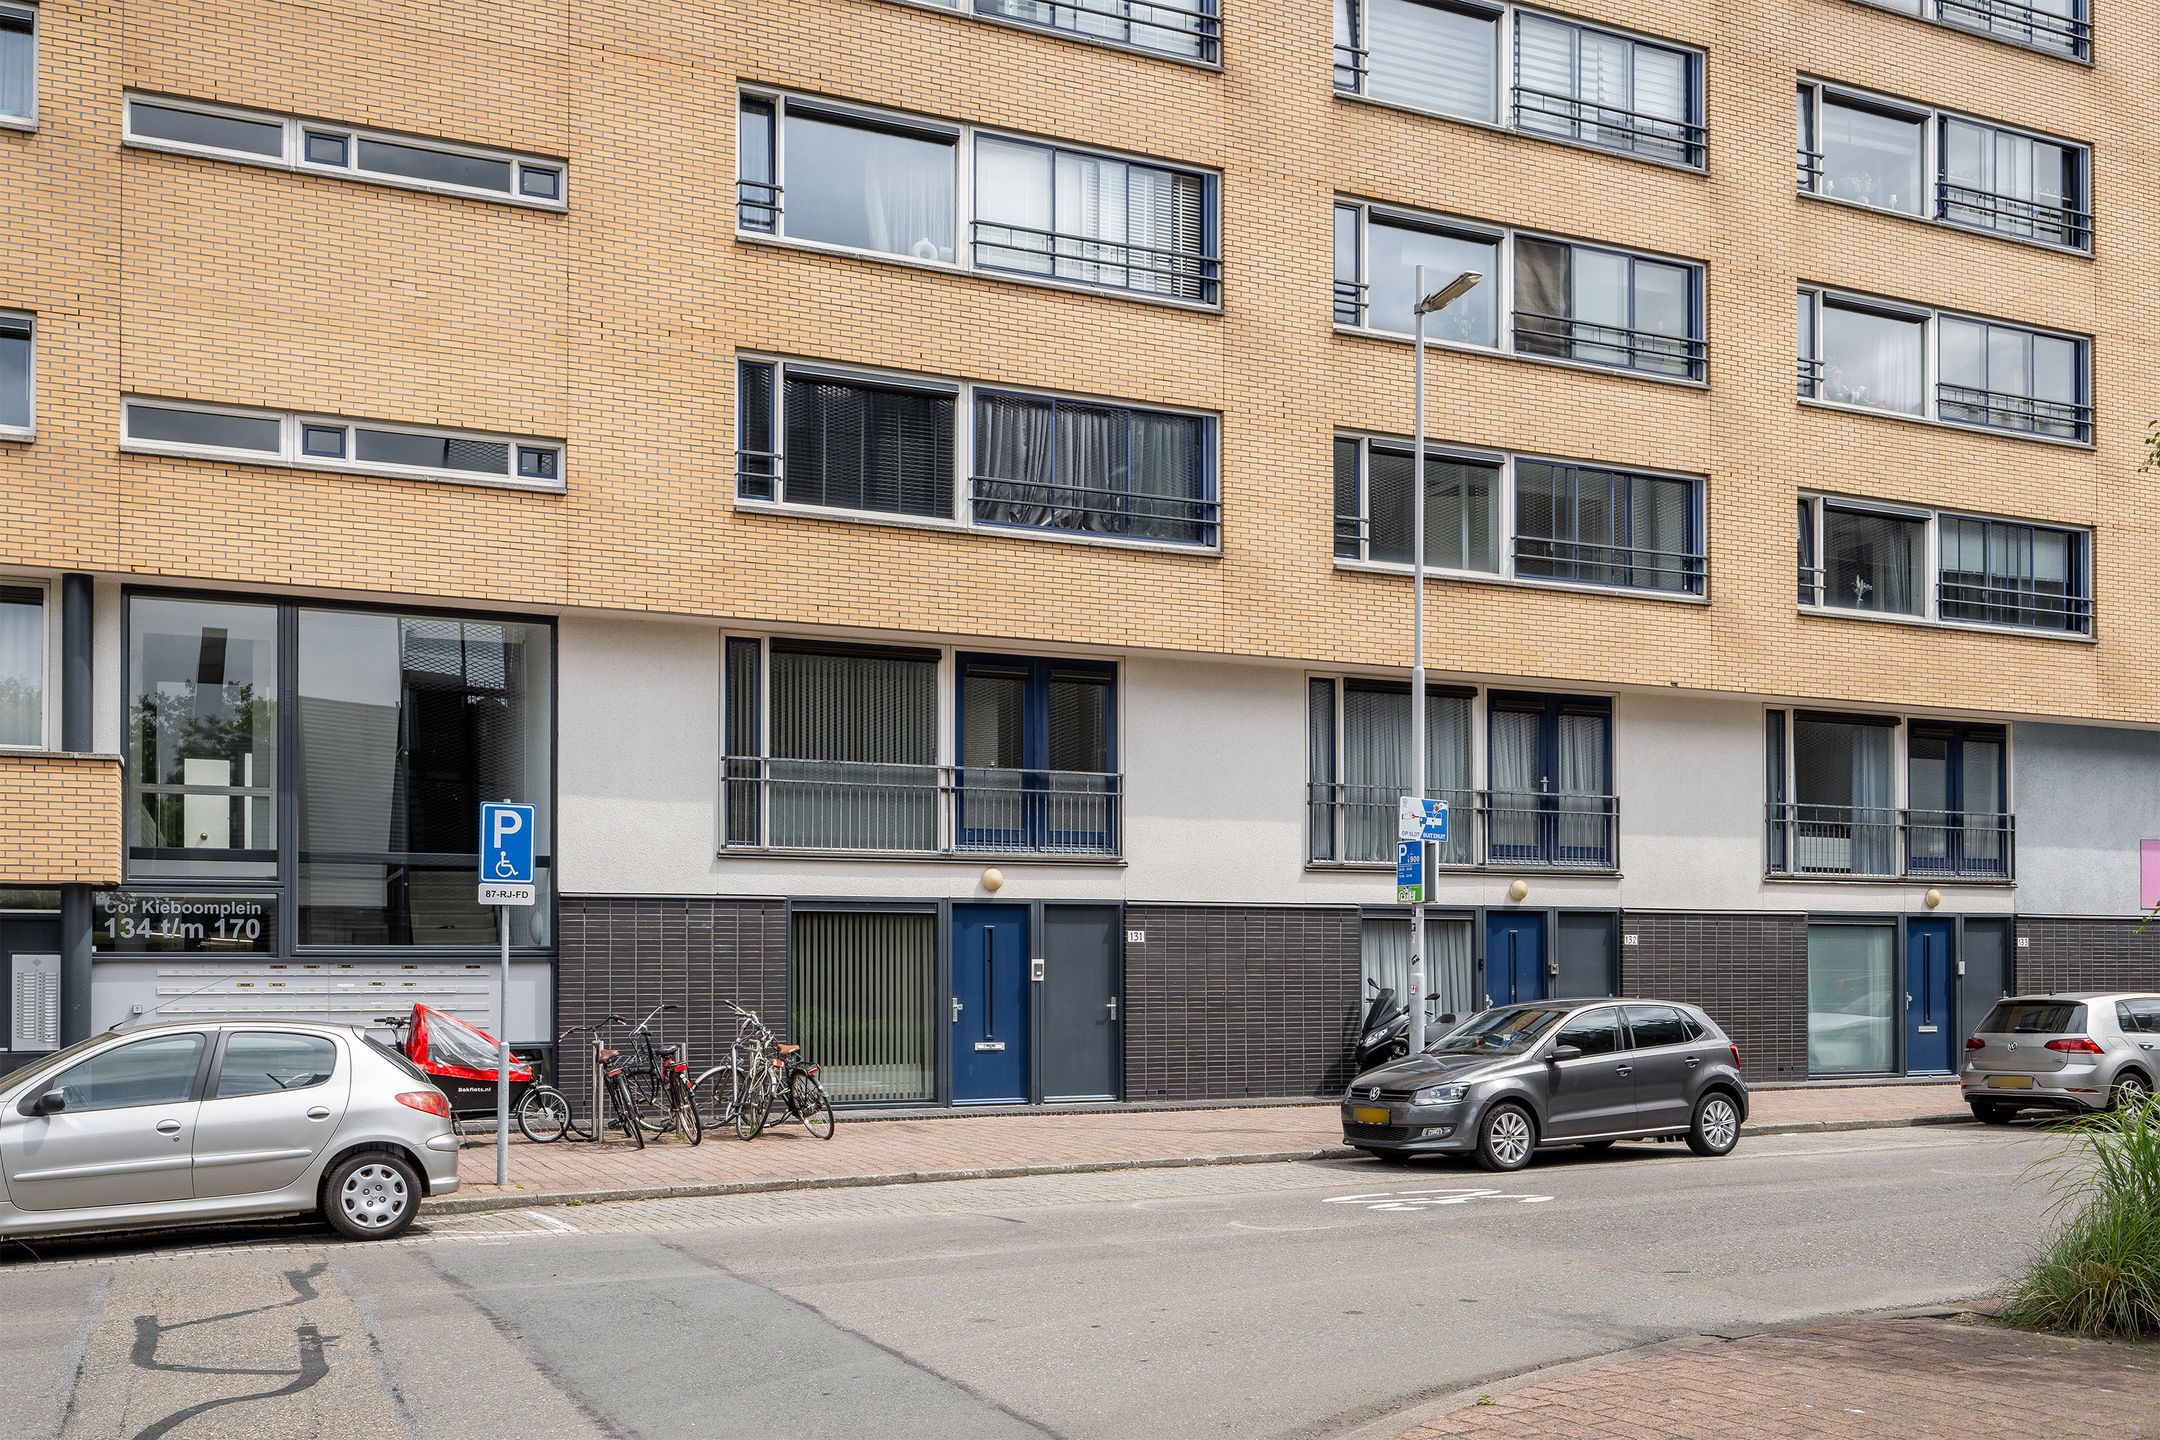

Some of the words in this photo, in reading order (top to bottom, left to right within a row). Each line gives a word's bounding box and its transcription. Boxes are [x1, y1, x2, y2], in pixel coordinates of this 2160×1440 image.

[493, 809, 523, 849] P
[1398, 844, 1407, 864] P
[485, 889, 529, 899] 87-RJ-FD
[104, 901, 137, 914] Cor
[141, 900, 262, 917] Kieboomplein
[104, 917, 152, 939] 134
[160, 917, 204, 939] t/m
[214, 918, 261, 939] 170
[1130, 932, 1143, 941] 131
[1625, 935, 1637, 944] 132
